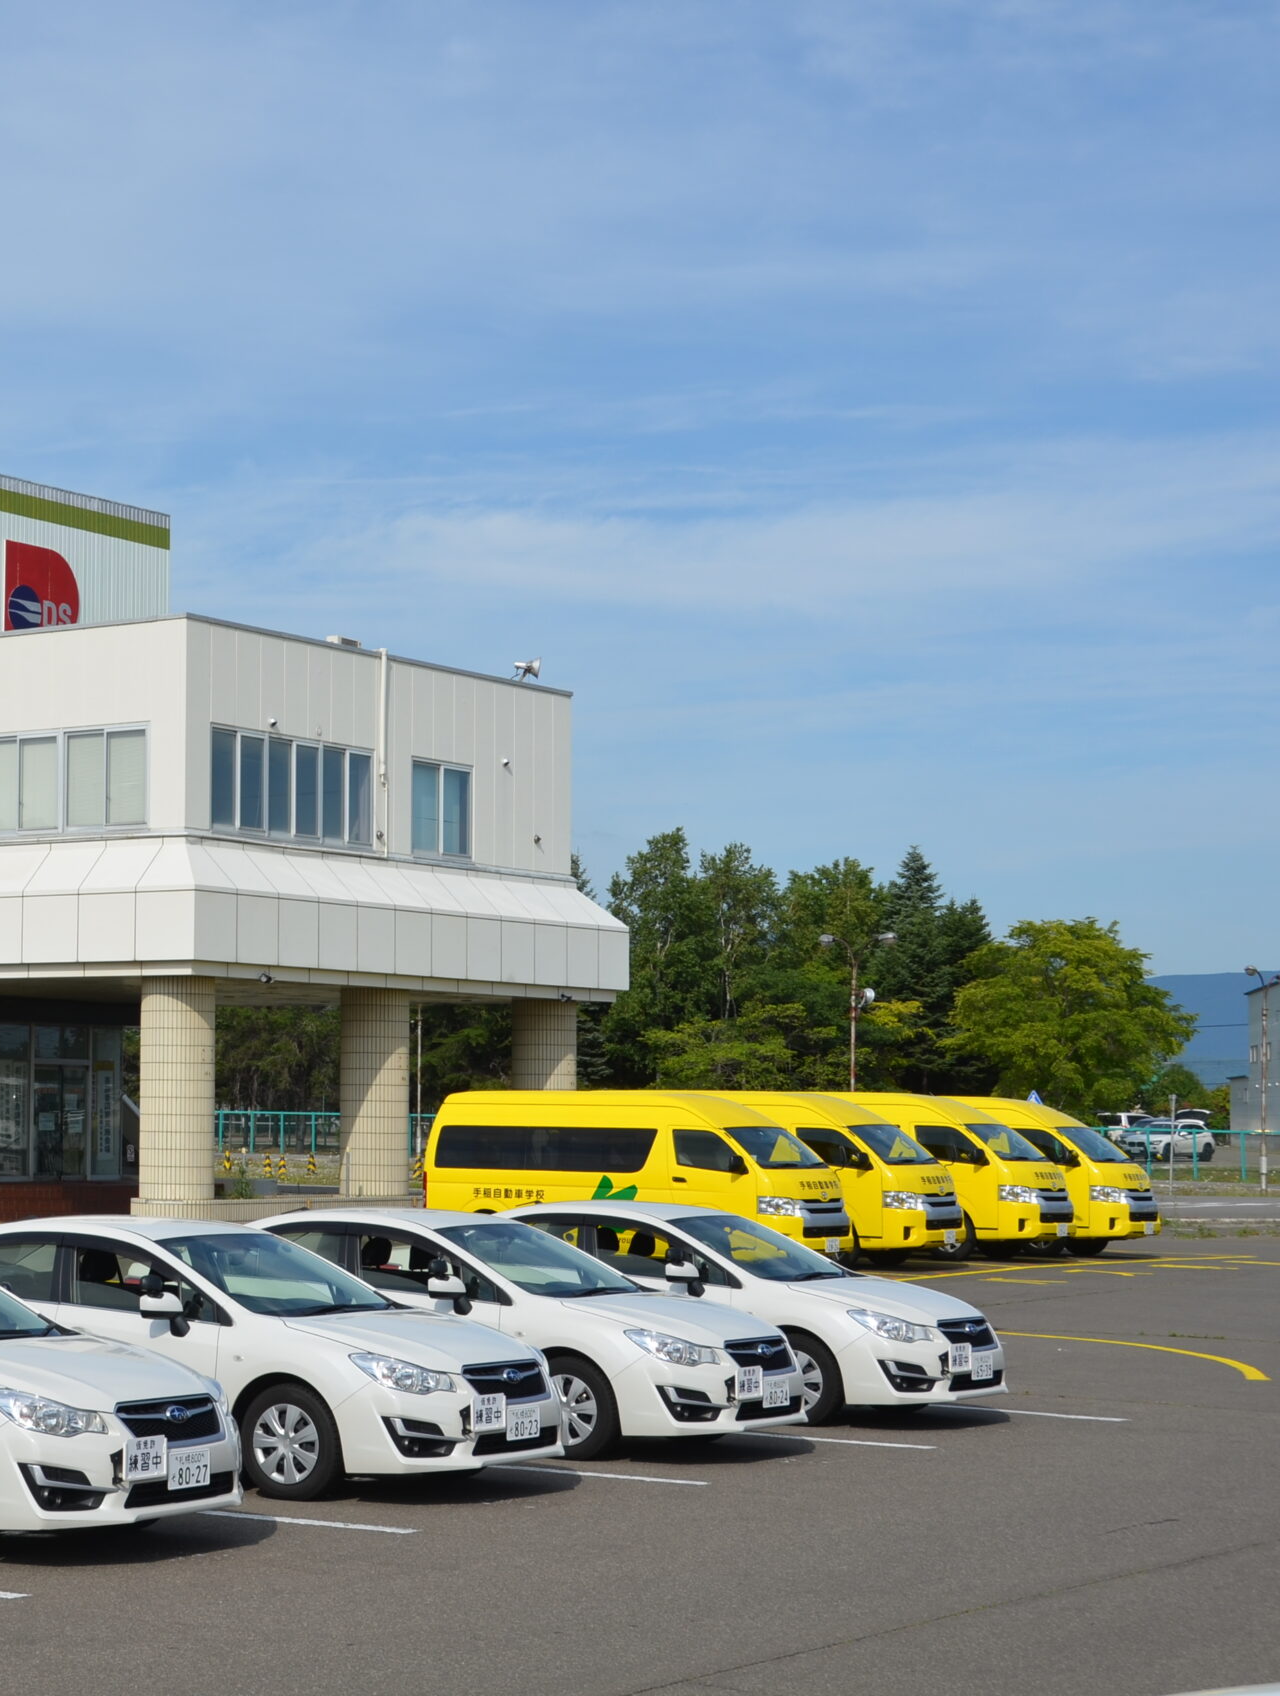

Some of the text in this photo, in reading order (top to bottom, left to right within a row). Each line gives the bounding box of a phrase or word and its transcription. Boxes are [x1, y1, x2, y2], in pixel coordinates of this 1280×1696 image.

[473, 1187, 545, 1200] 手稲自動車学校
[514, 1419, 539, 1437] 80-23
[128, 1451, 162, 1473] 練習中
[178, 1464, 208, 1486] 80-27
